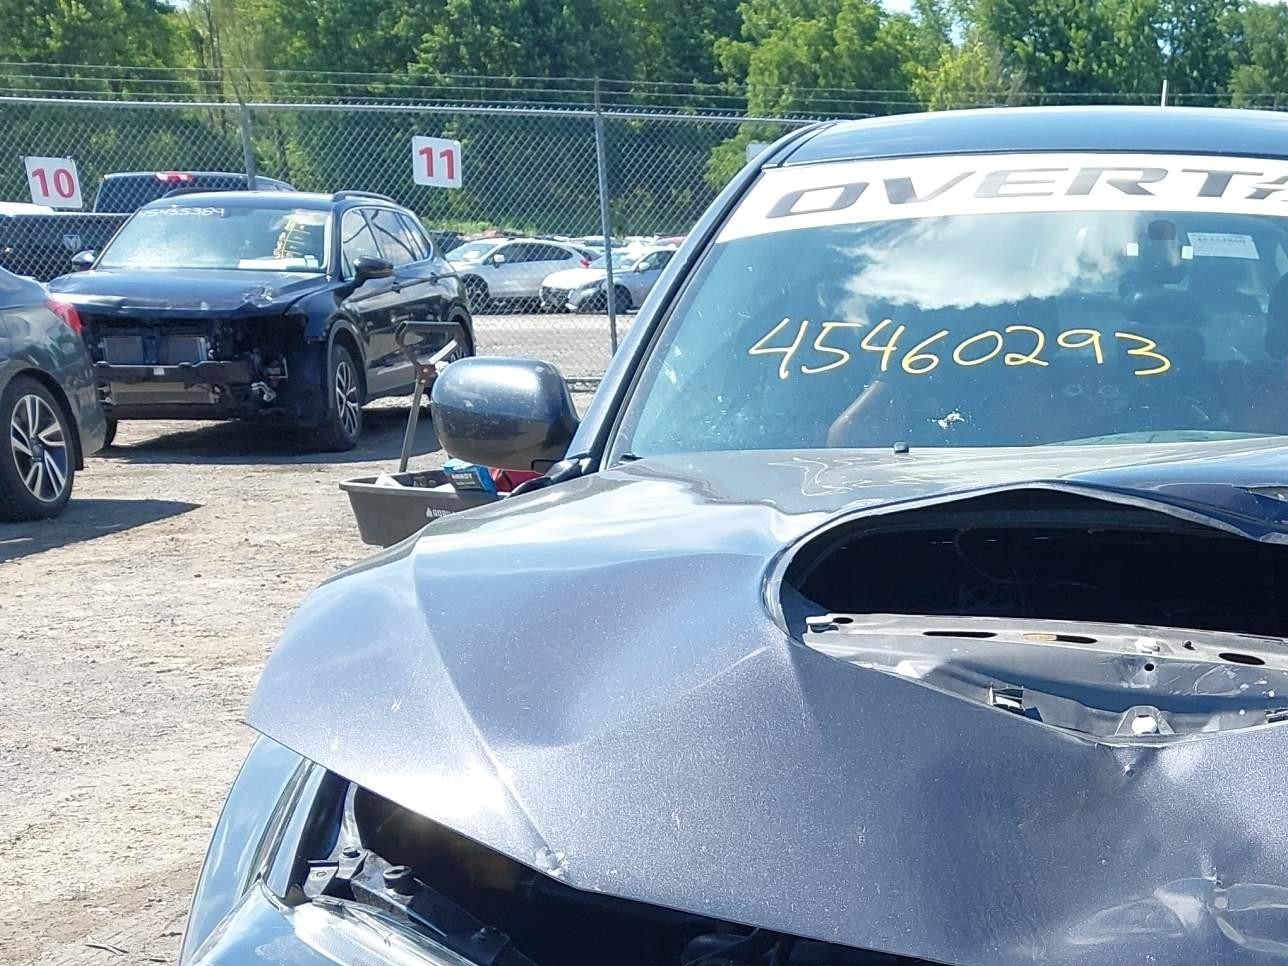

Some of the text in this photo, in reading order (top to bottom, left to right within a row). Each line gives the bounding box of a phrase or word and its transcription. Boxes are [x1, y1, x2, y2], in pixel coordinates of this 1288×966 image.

[419, 146, 454, 180] 11
[31, 167, 75, 199] 10
[748, 317, 1171, 380] 45460293
